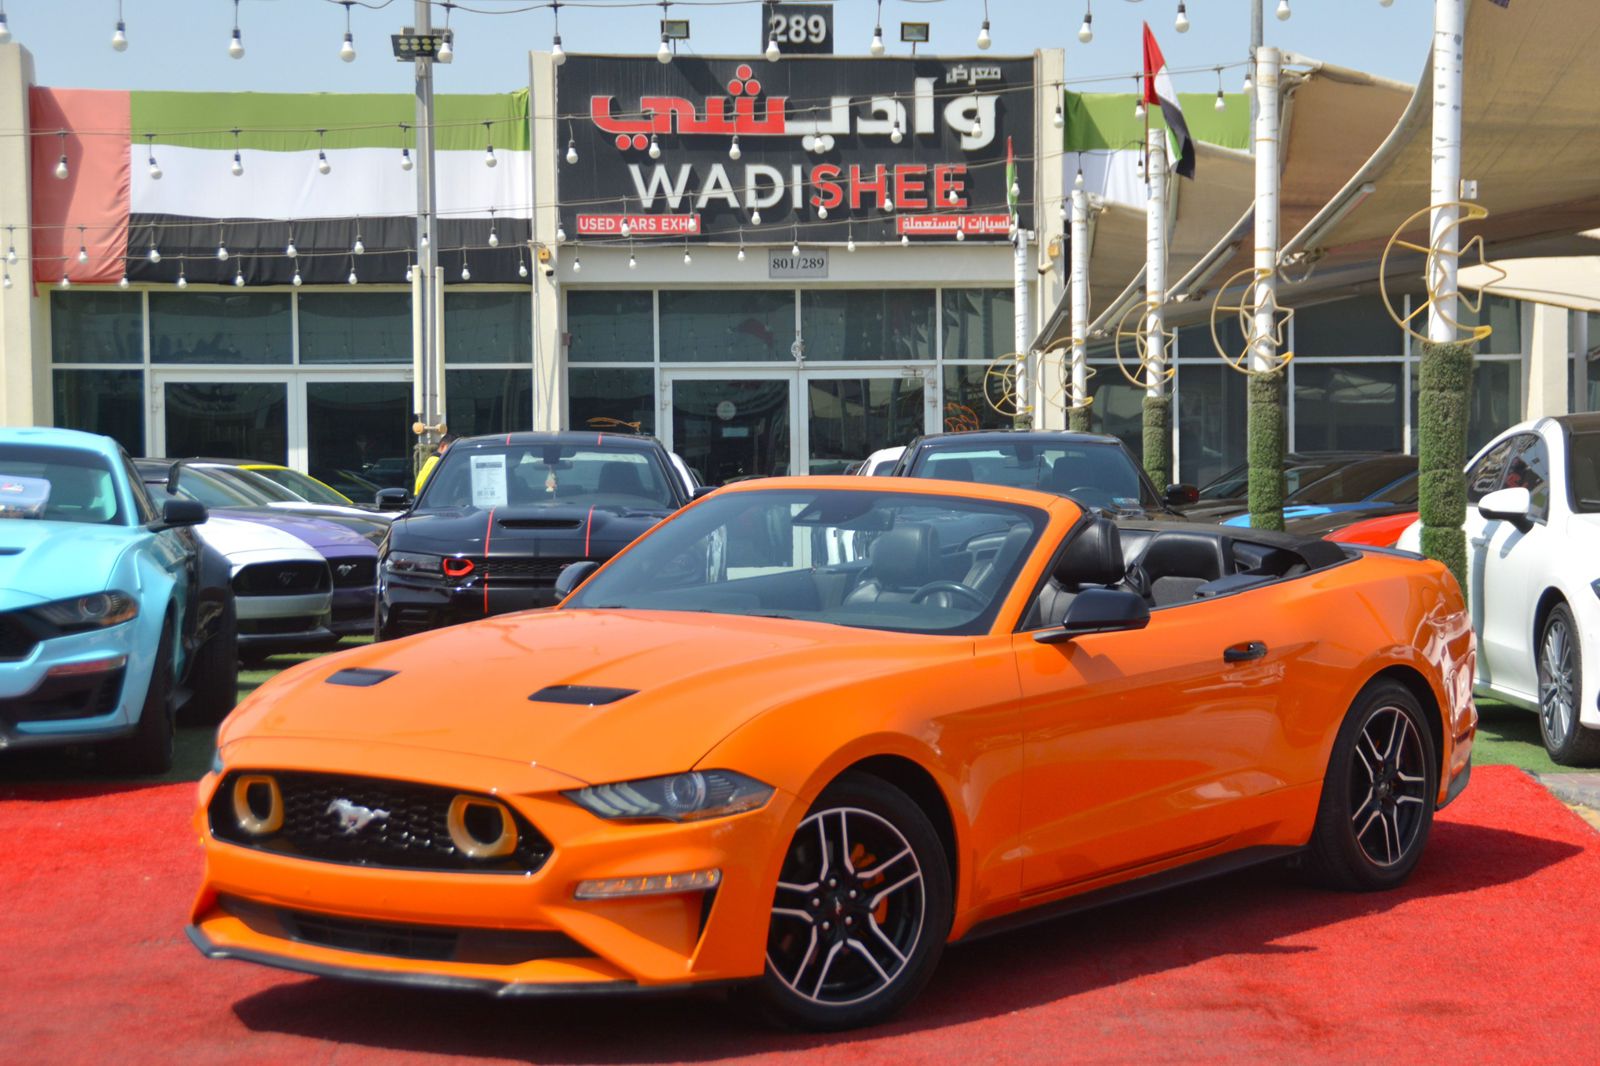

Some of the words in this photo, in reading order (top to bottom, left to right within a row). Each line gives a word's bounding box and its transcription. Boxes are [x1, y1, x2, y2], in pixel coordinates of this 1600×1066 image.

[769, 14, 826, 44] 289
[946, 64, 1001, 85] معرض
[628, 163, 968, 209] WADISHEE
[579, 217, 615, 231] USED
[661, 217, 697, 232] EXH
[772, 257, 825, 270] 801/289
